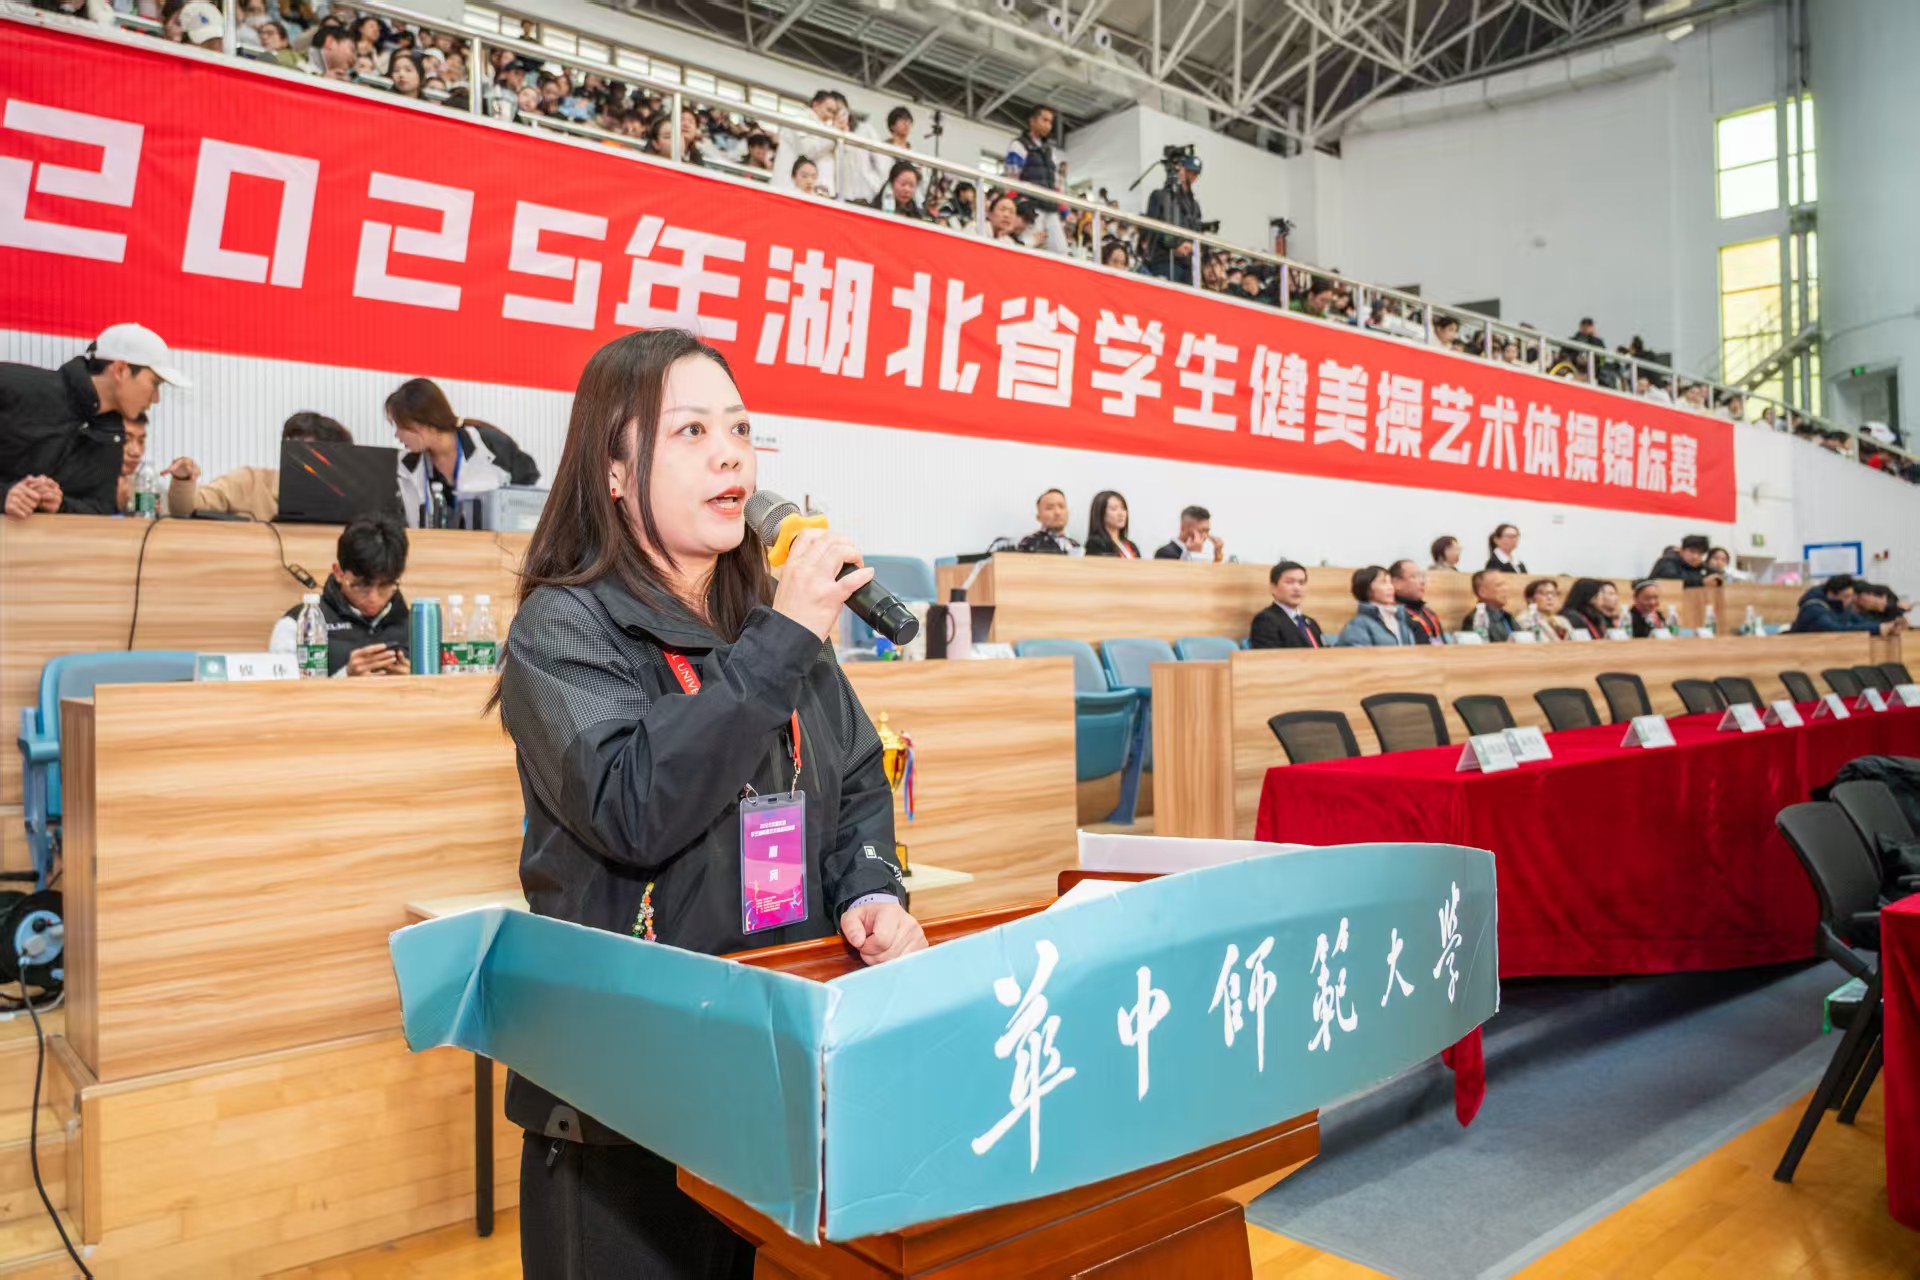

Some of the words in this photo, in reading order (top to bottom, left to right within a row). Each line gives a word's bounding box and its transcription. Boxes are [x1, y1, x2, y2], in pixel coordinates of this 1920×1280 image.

[0, 98, 1698, 497] 2025年湖北省学生健美操艺术体操锦标赛
